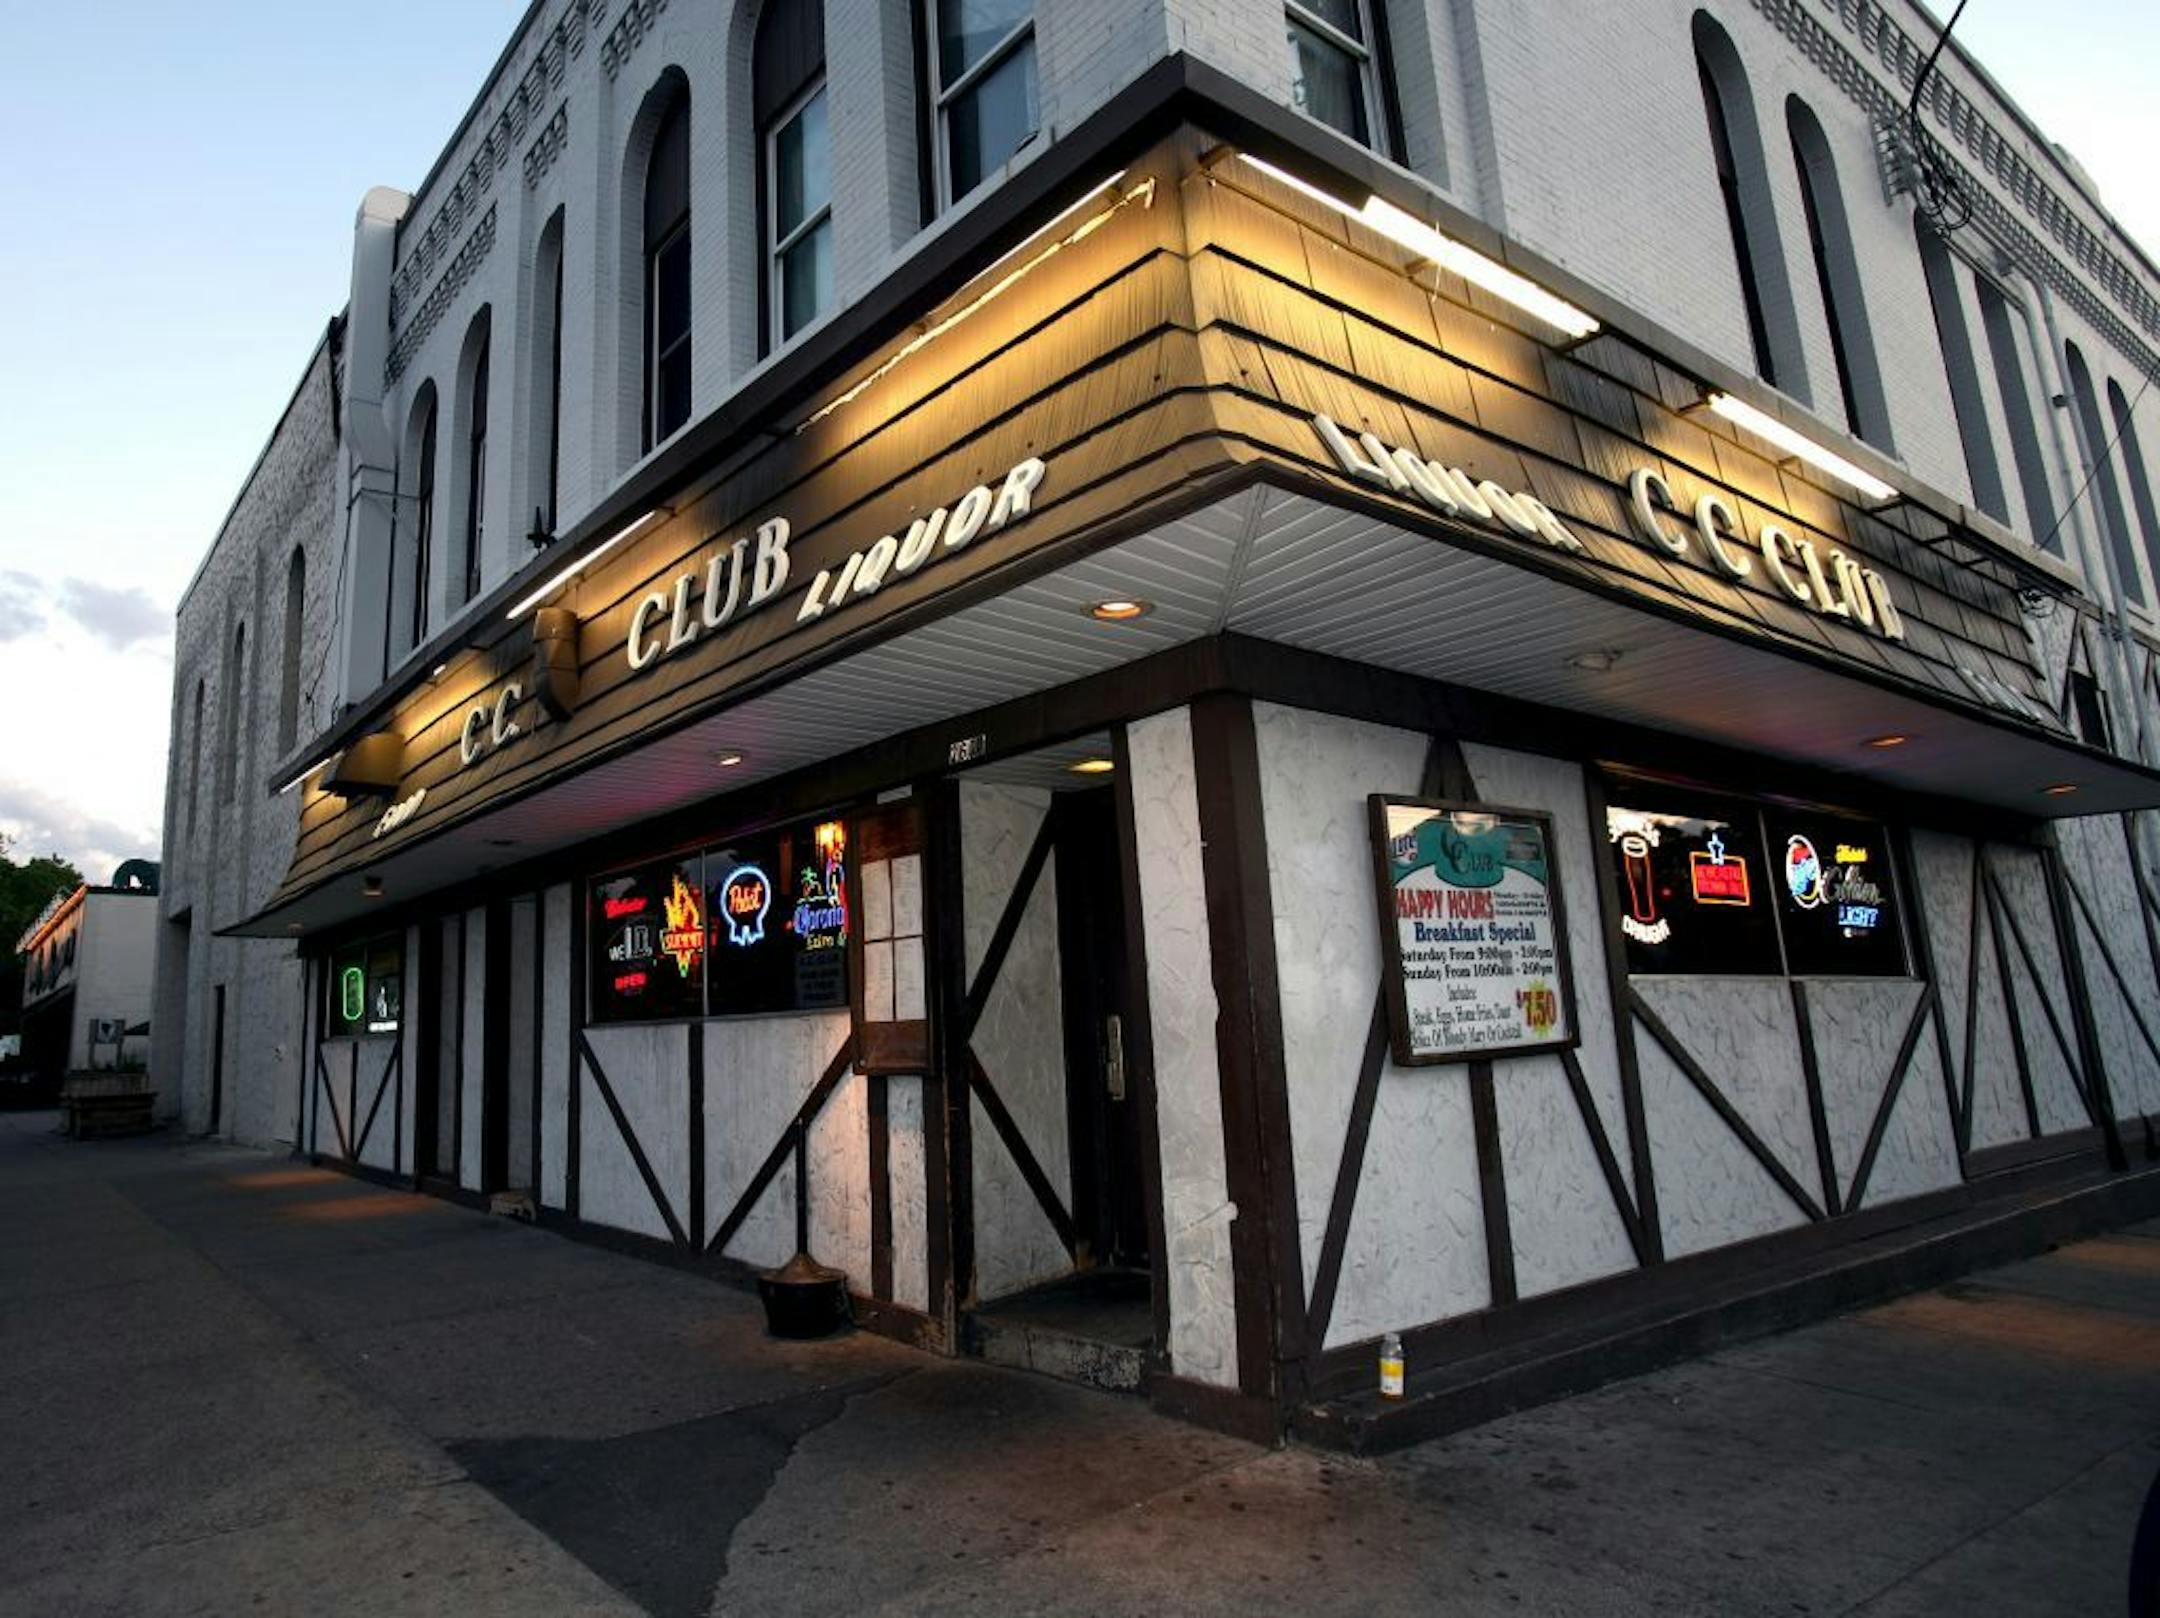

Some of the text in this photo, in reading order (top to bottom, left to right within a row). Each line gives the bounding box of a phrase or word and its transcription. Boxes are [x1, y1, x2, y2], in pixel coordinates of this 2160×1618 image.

[1313, 411, 1584, 550] LIQUOR
[797, 457, 1046, 621] LIQUOR
[628, 516, 791, 671] CLUB
[1761, 524, 1904, 641] CLUB
[1397, 889, 1494, 920] HAPPY HOURS
[1838, 905, 1879, 928] LIGHT
[1414, 921, 1536, 945] Breakfast Special
[1450, 948, 1475, 961] From
[1402, 965, 1442, 980] Sunday
[1445, 964, 1471, 978] From
